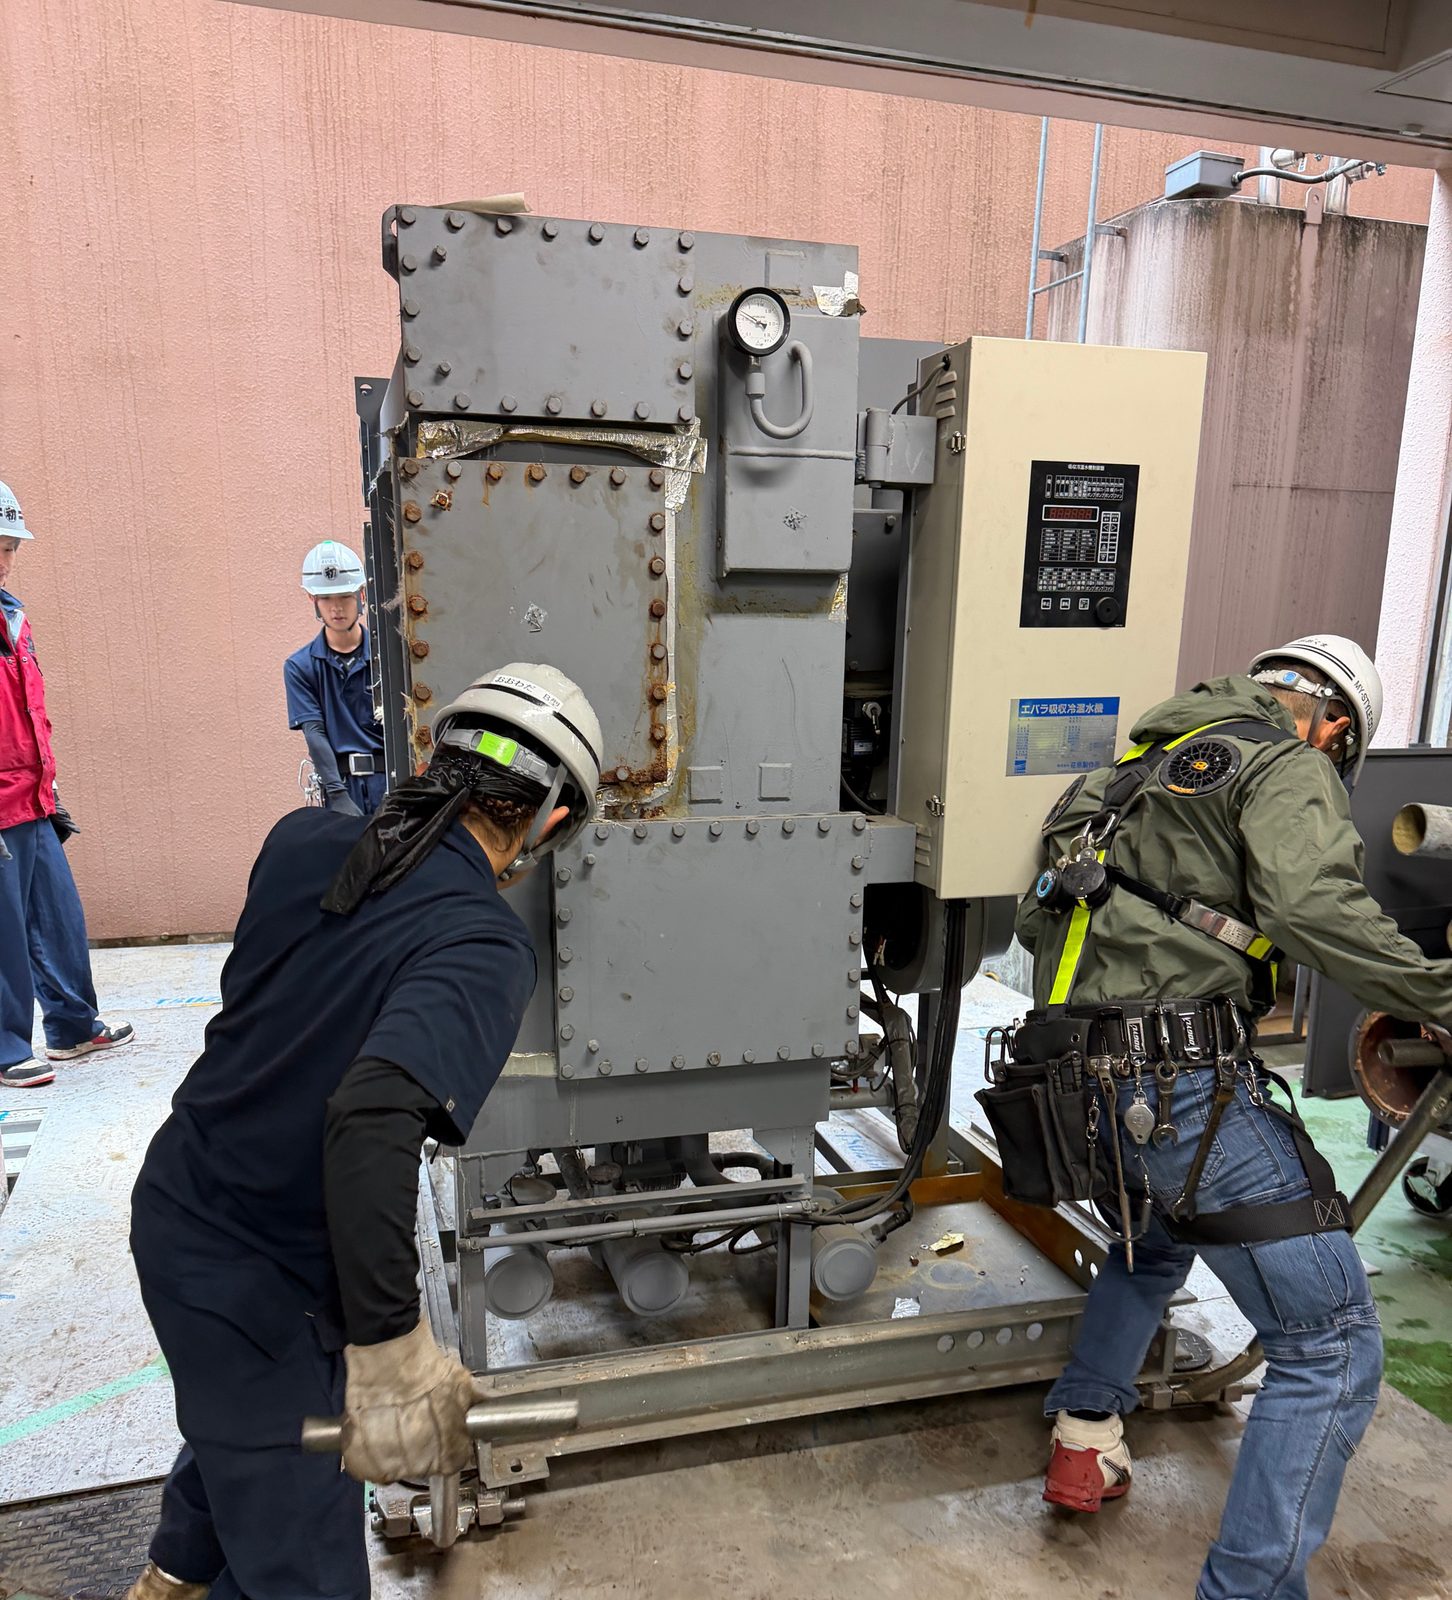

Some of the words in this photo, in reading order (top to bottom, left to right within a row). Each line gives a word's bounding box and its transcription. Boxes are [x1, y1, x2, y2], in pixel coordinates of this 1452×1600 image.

[495, 676, 536, 693] おおわだ
[1021, 702, 1104, 714] エバラ吸収冷温水機
